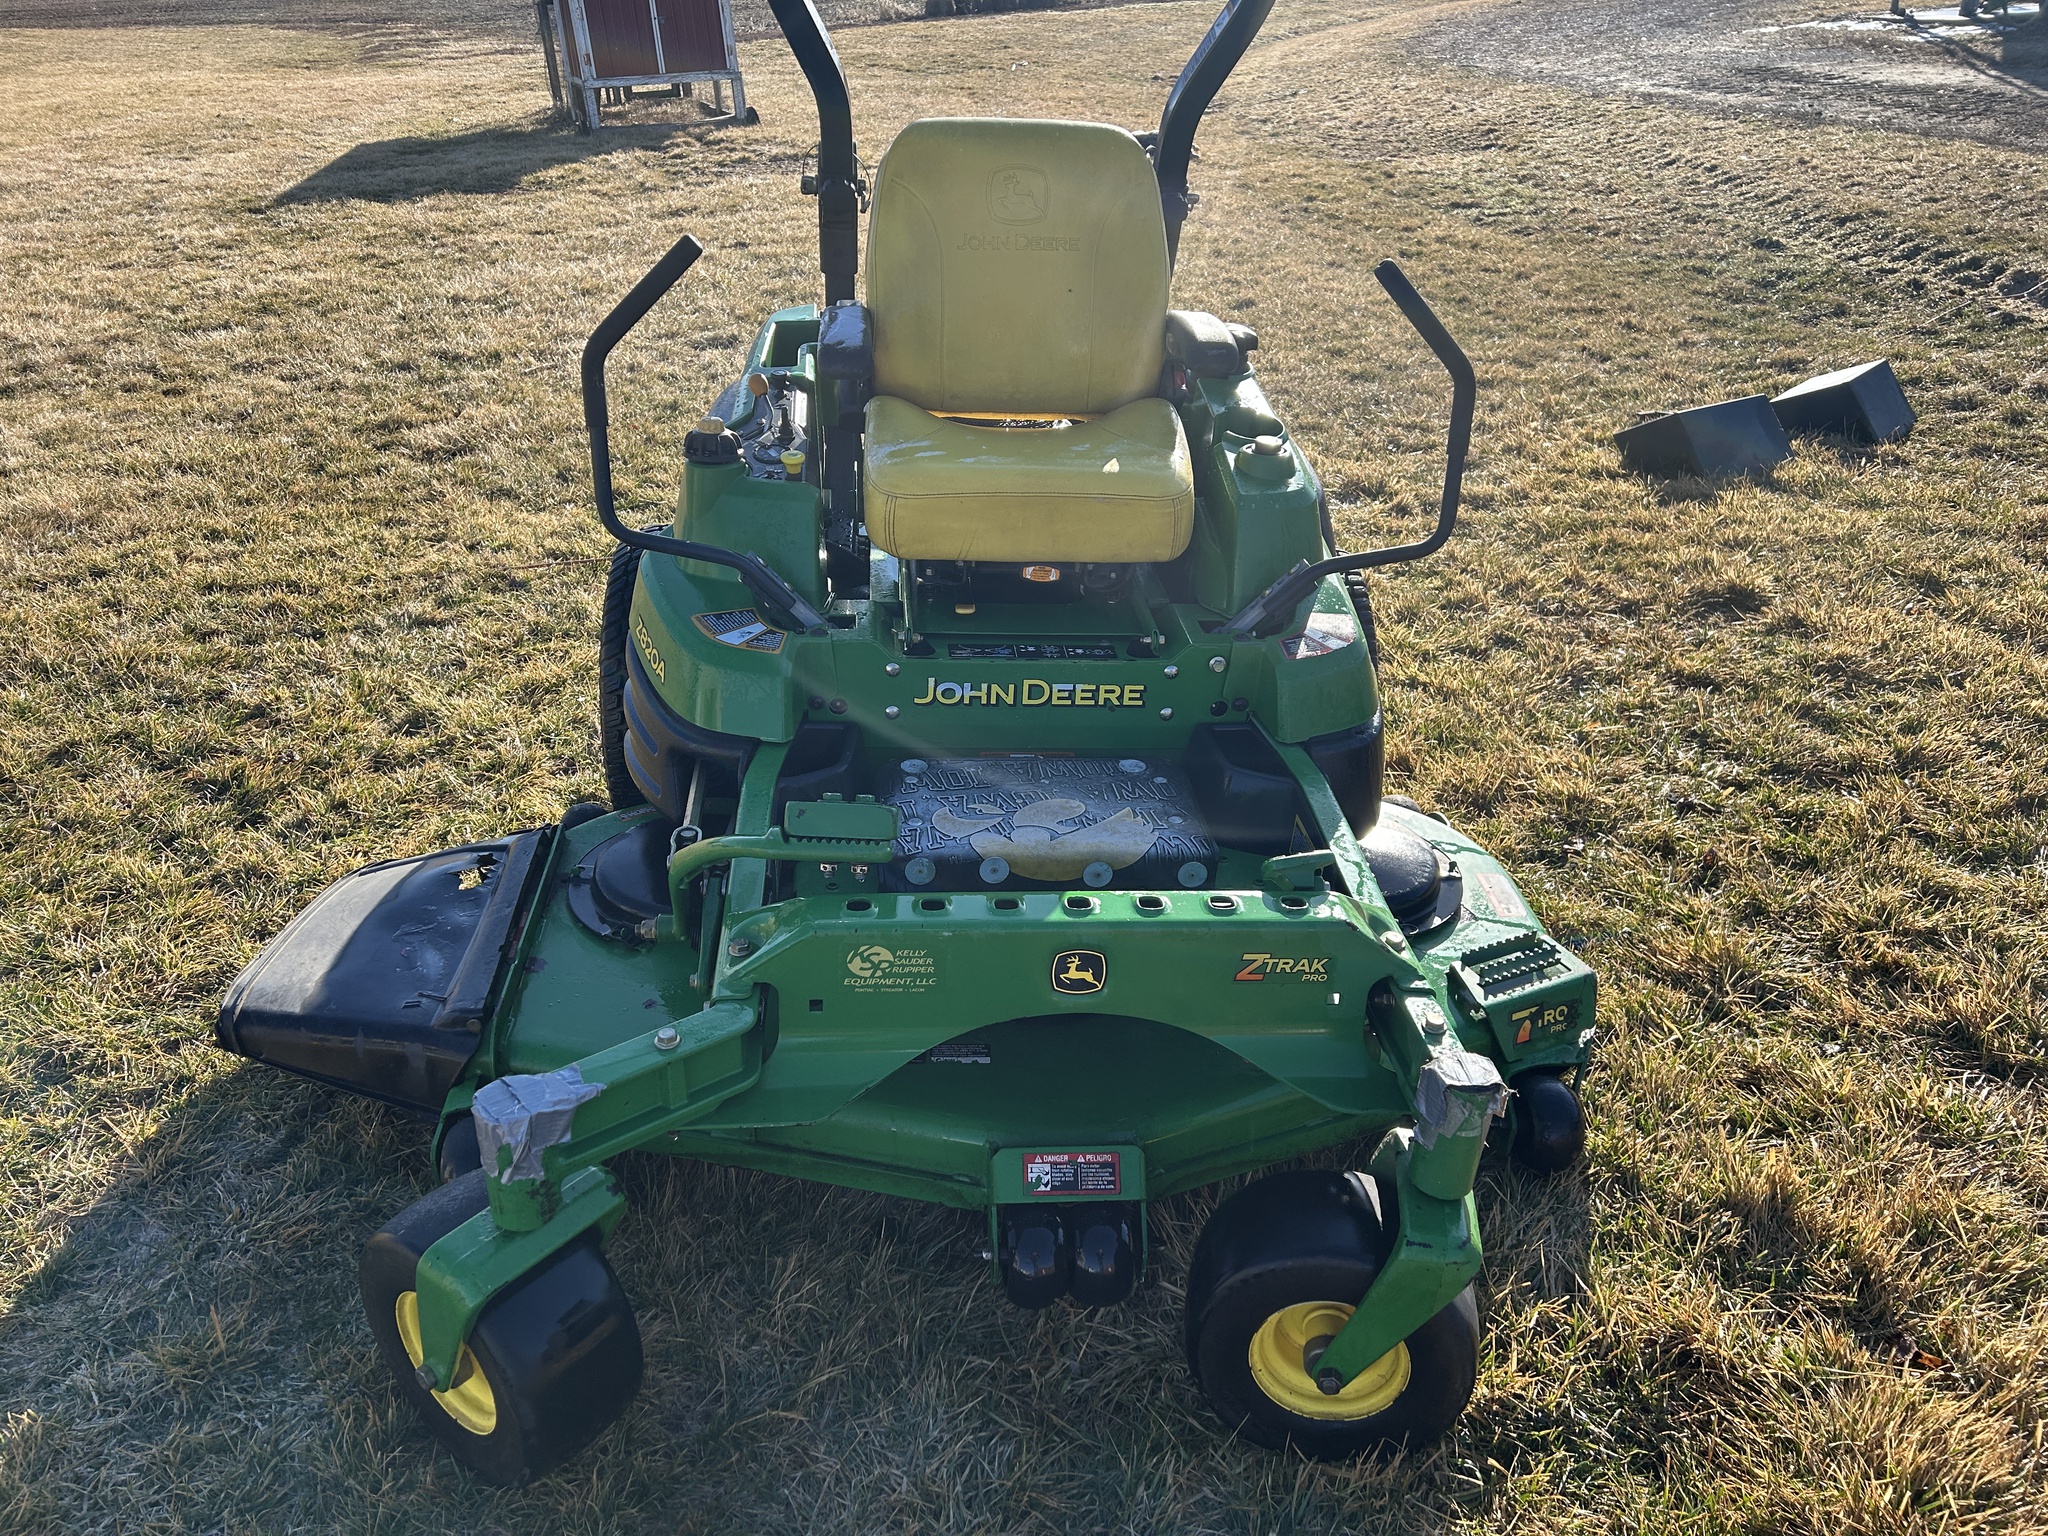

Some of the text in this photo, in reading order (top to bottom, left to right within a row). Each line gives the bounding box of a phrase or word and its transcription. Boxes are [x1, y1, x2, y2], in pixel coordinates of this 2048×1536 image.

[956, 232, 1081, 252] JOHN DEERE
[635, 614, 665, 684] Z820A
[913, 677, 1146, 707] JOHN DEERE
[892, 966, 935, 974] RUPIPER
[843, 978, 914, 986] EQUIPMENT,
[1301, 974, 1328, 982] PRO
[1086, 1154, 1112, 1162] PELIGRO
